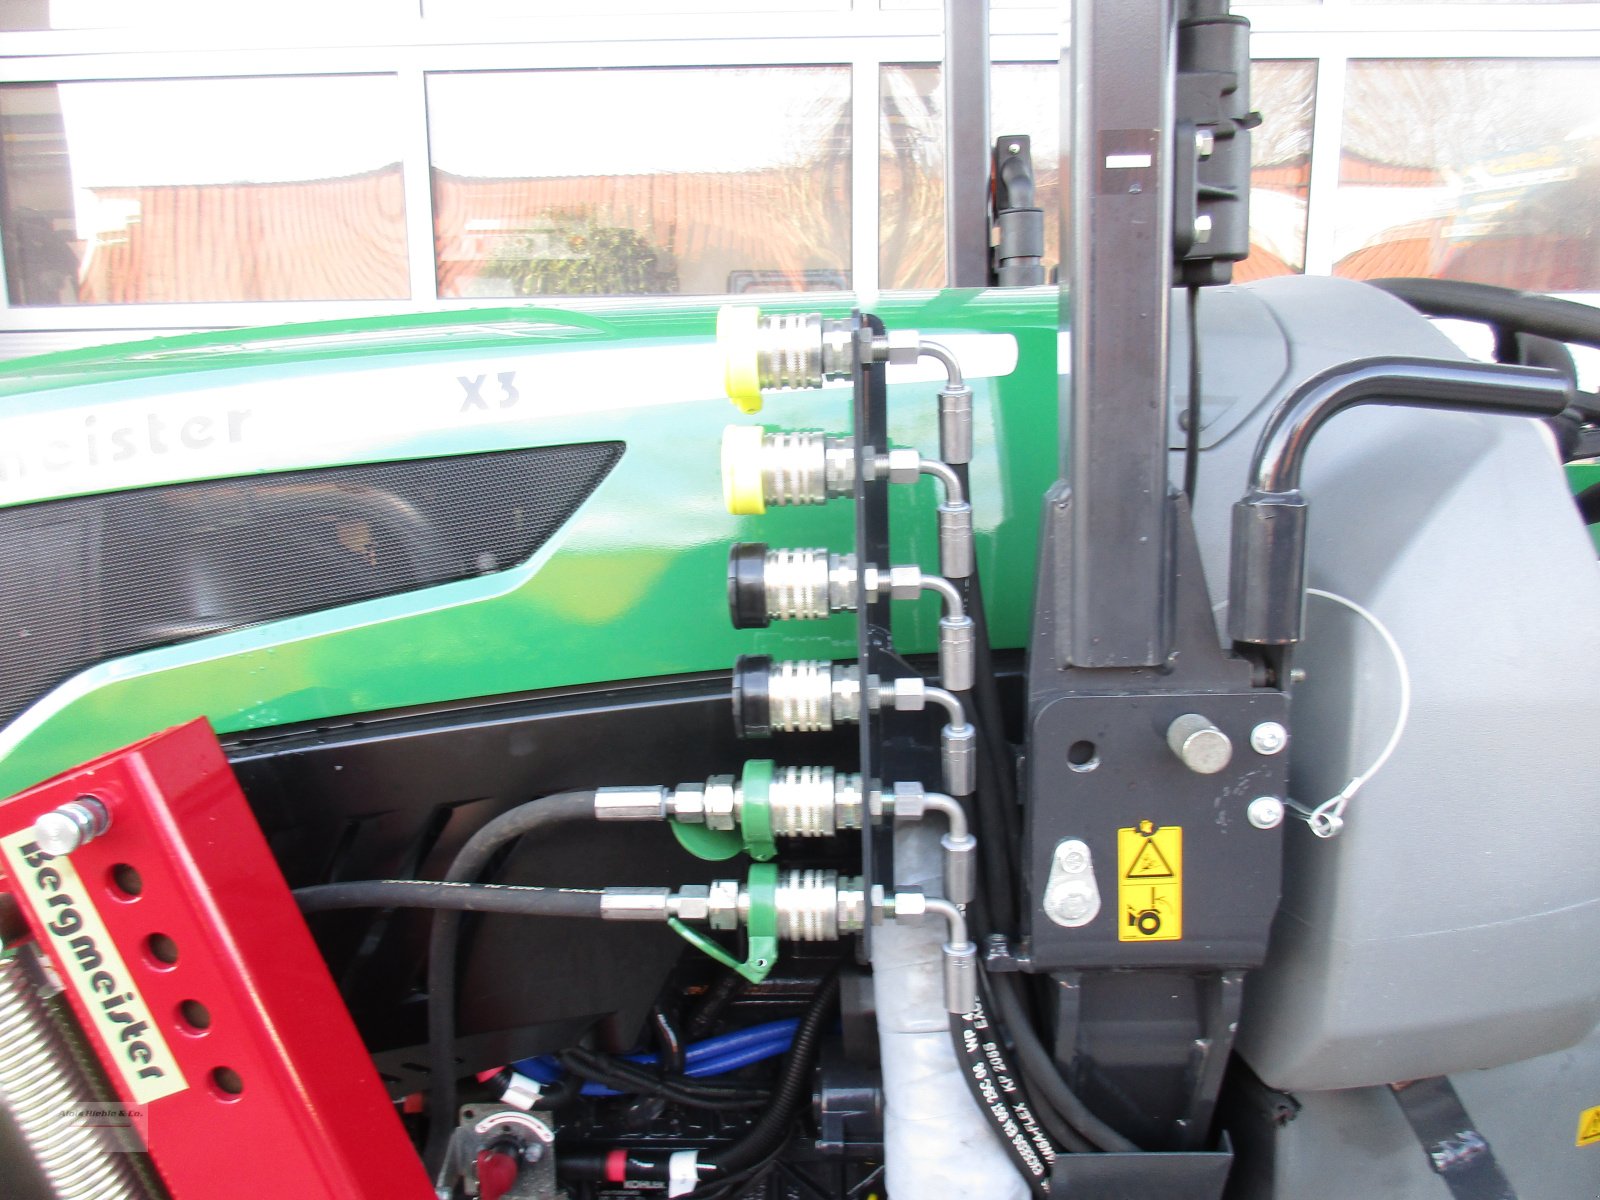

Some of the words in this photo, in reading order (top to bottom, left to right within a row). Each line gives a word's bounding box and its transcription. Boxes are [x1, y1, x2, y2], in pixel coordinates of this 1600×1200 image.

[456, 370, 520, 412] X3
[963, 1029, 979, 1053] WP
[997, 1075, 1017, 1093] KP
